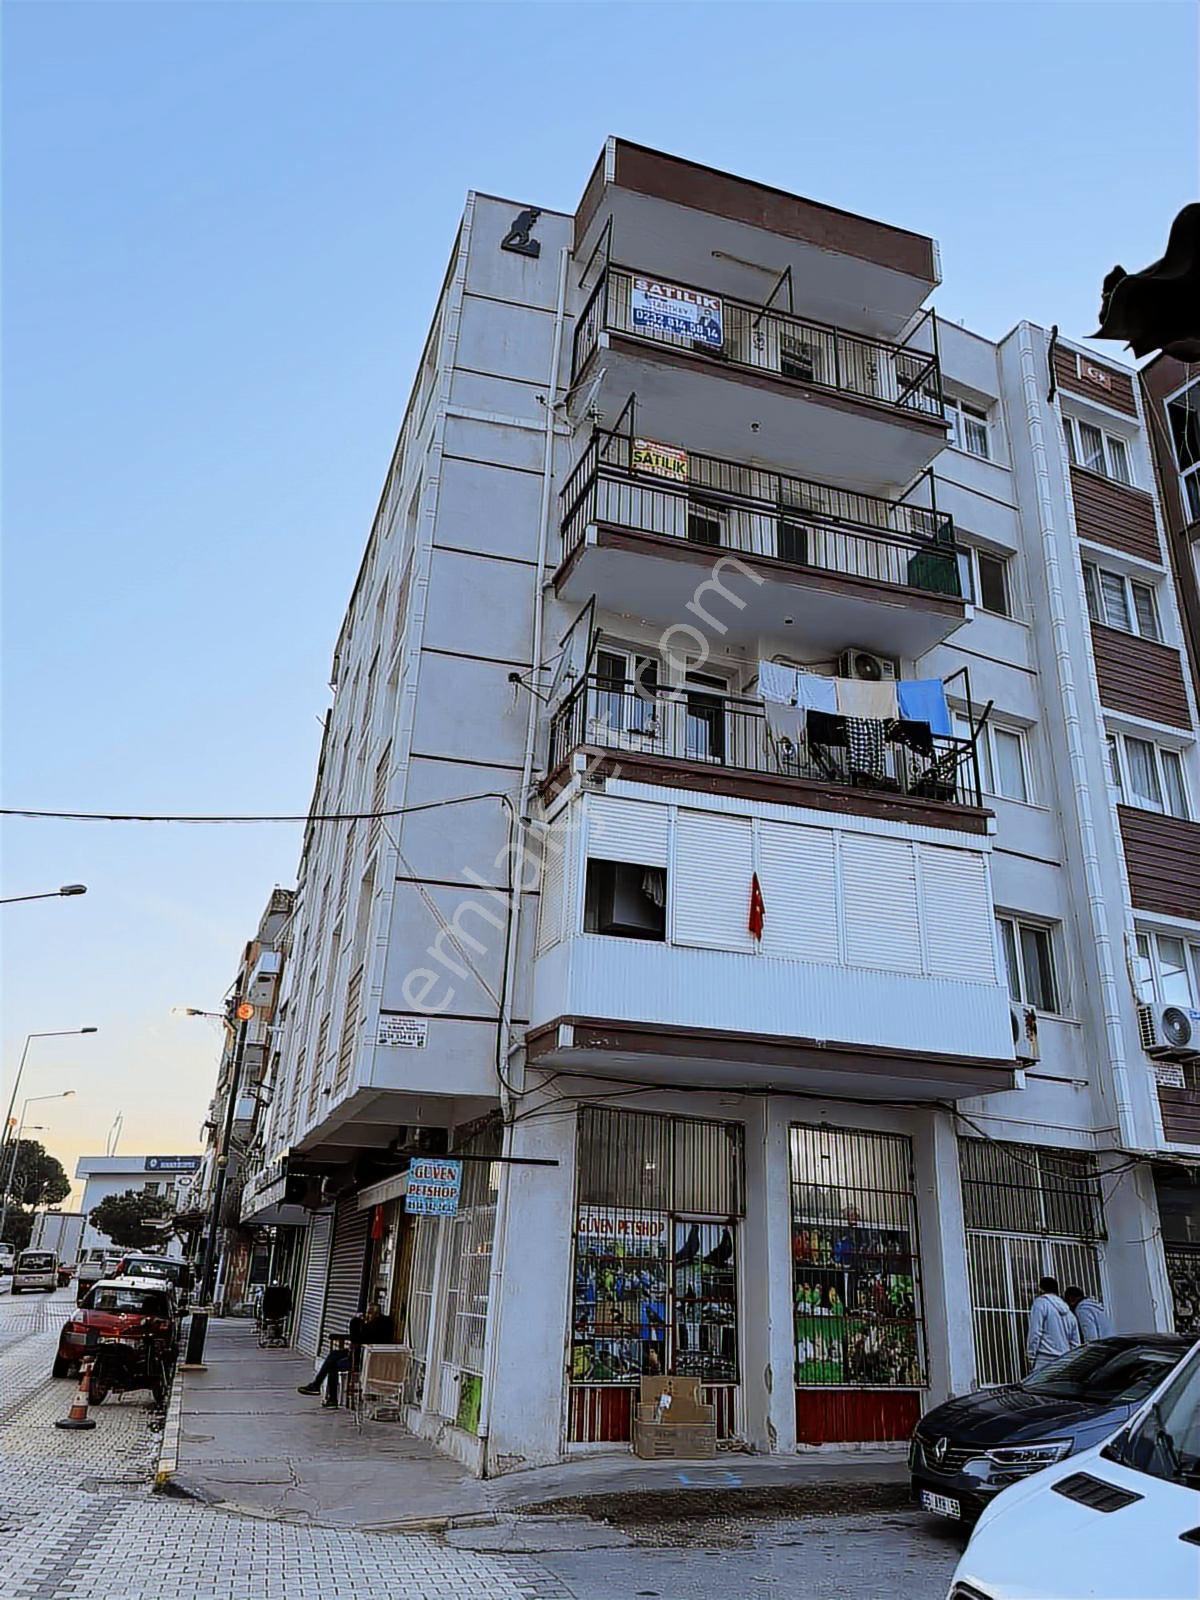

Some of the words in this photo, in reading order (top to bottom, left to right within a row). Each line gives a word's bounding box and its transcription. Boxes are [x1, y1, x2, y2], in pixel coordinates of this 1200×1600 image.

[635, 280, 720, 310] SATILIK
[634, 451, 685, 474] SATILIK
[409, 1184, 458, 1198] PETSHOP
[579, 1213, 614, 1234] GÜVEN
[617, 1219, 665, 1237] PETSHOP
